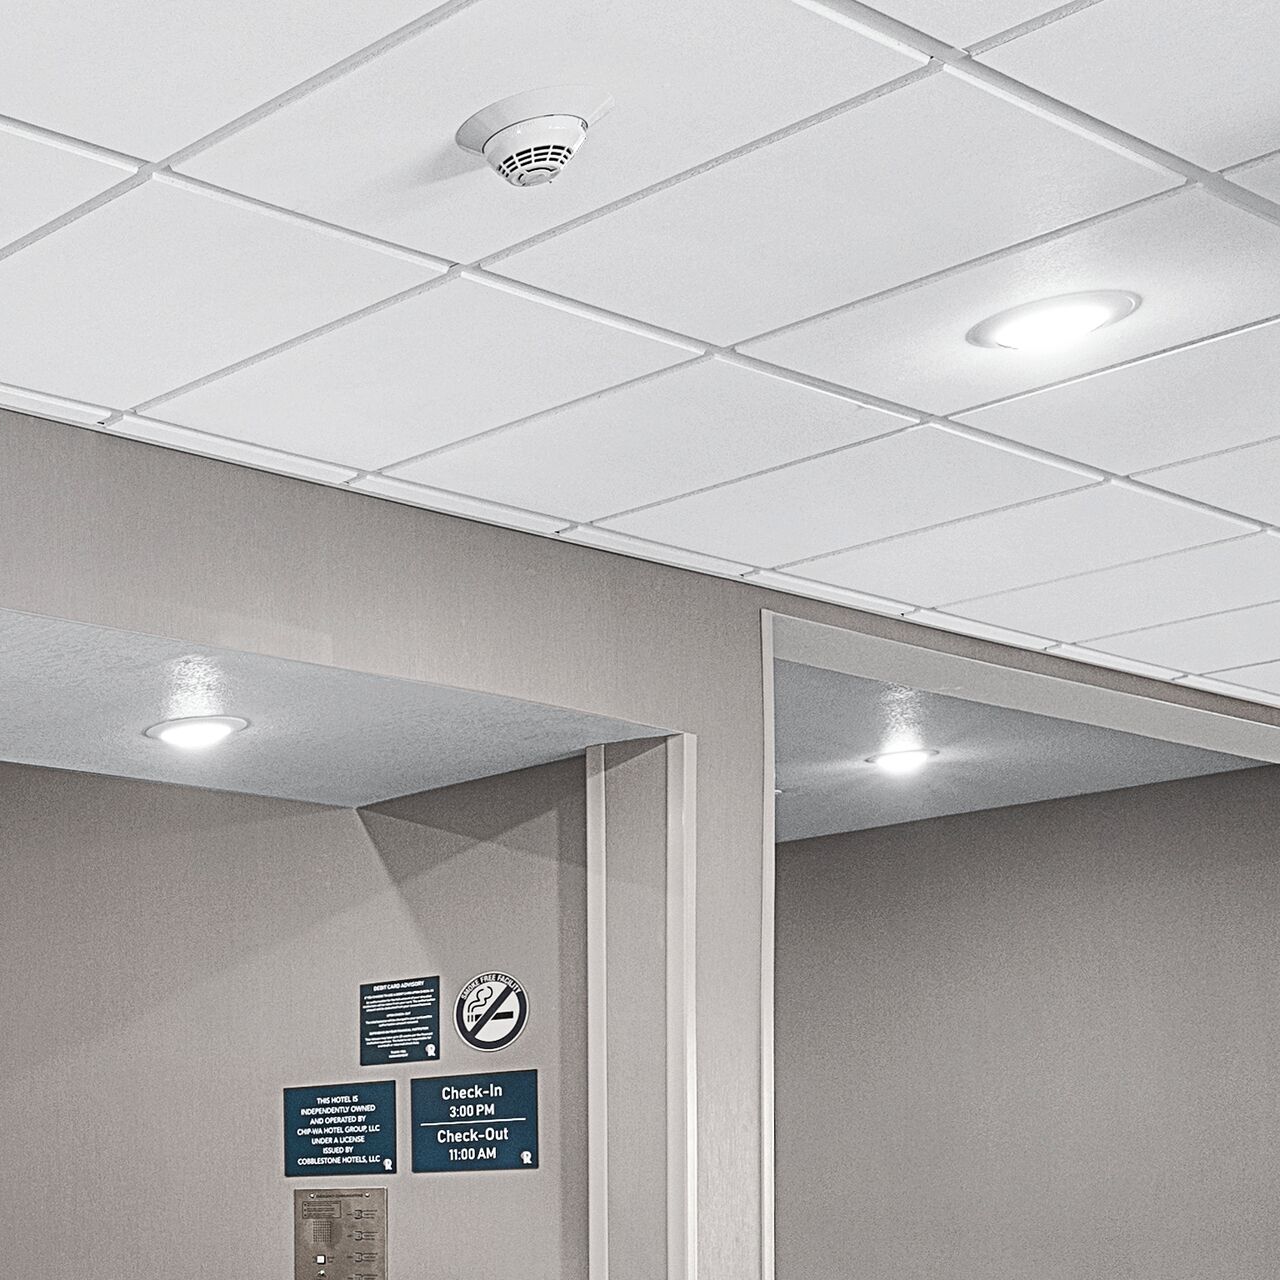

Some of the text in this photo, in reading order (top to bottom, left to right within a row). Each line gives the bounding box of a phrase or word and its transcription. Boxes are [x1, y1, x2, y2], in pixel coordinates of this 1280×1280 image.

[460, 974, 521, 1000] SMOKE FREE FACILITY
[442, 1084, 502, 1100] Check-In
[331, 1096, 351, 1104] HOTEL
[300, 1104, 376, 1116] INDEPENDENTLY OWNED
[450, 1104, 495, 1118] 3:00 PM
[325, 1116, 356, 1124] OPERATED
[324, 1126, 344, 1134] HOTEL
[368, 1124, 380, 1132] LLC
[340, 1136, 366, 1144] LICENSE
[437, 1128, 508, 1143] Check-Out
[345, 1146, 354, 1154] BY
[448, 1147, 496, 1160] 11:00 AM
[298, 1158, 341, 1166] COBBLESTONE
[342, 1156, 368, 1164] HOTELS,
